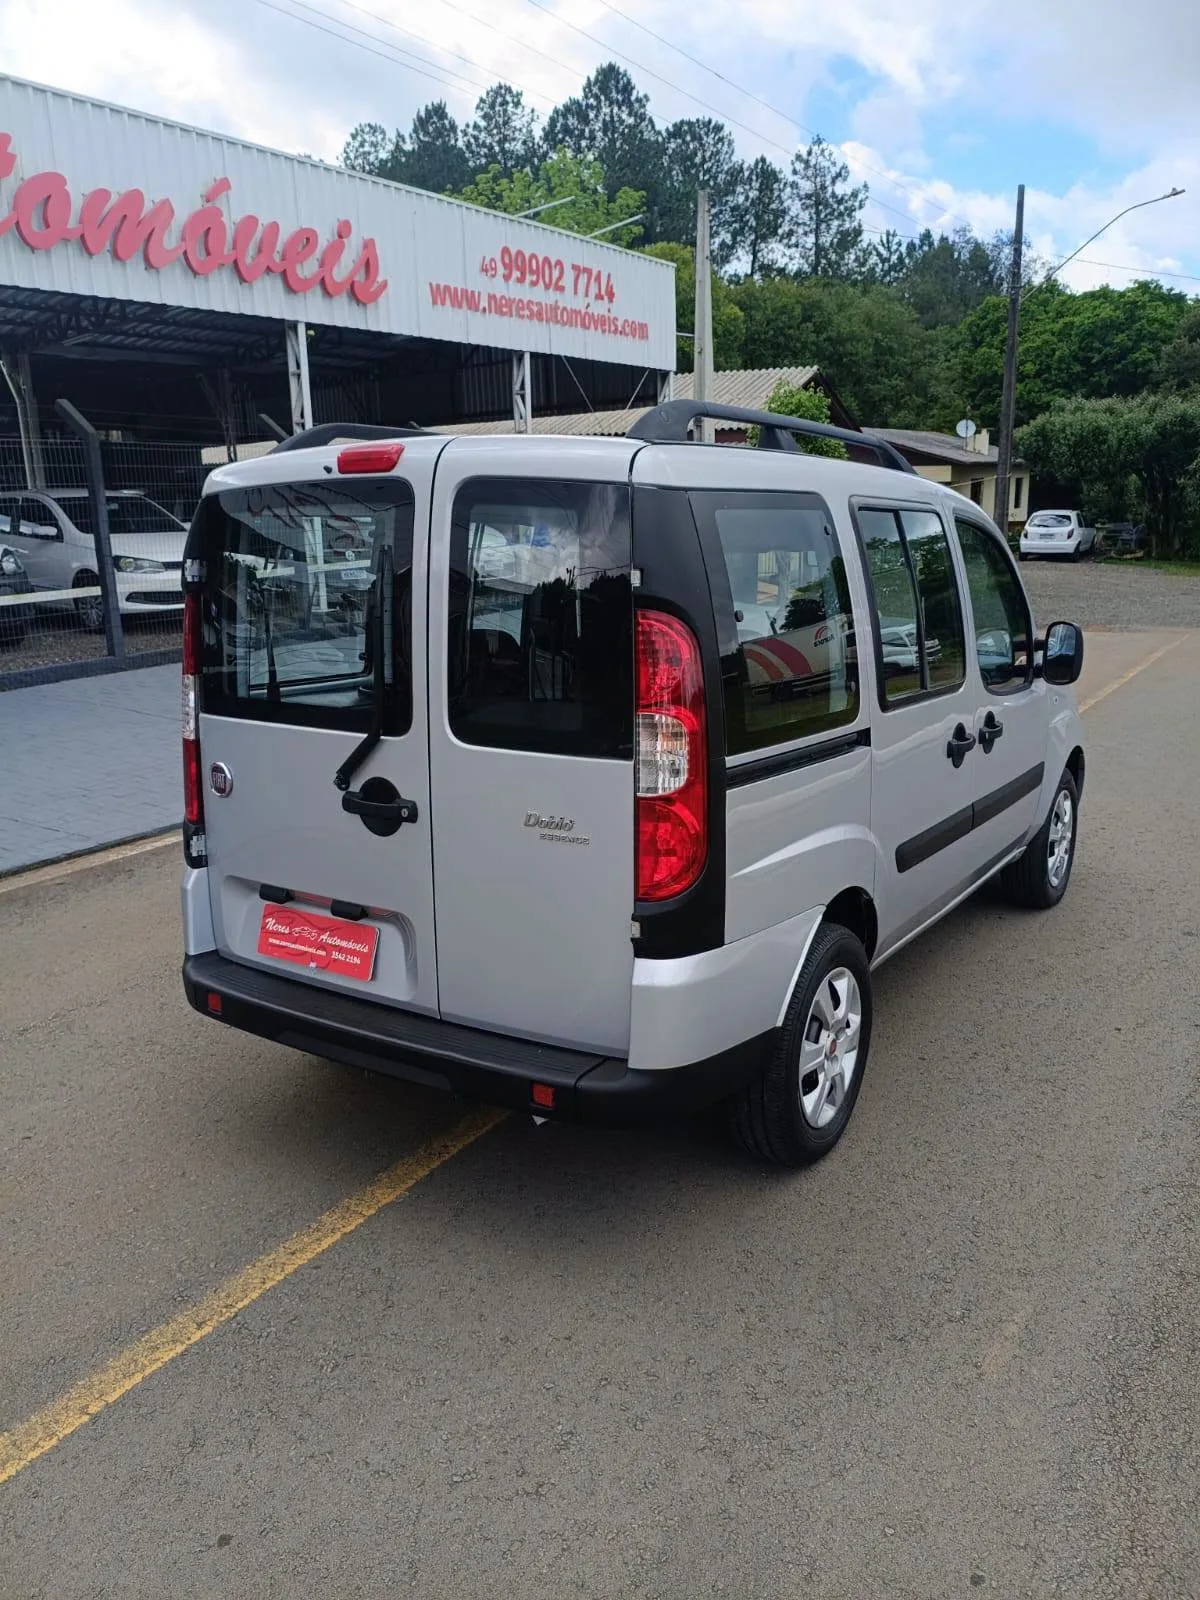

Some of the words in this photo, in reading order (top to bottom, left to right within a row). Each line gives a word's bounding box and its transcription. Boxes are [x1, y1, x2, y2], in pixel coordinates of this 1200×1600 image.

[480, 255, 497, 278] 49
[501, 245, 566, 294] 99902
[571, 263, 616, 304] 7714
[429, 282, 650, 341] www.neresautomóveis.com
[265, 917, 290, 934] Neres
